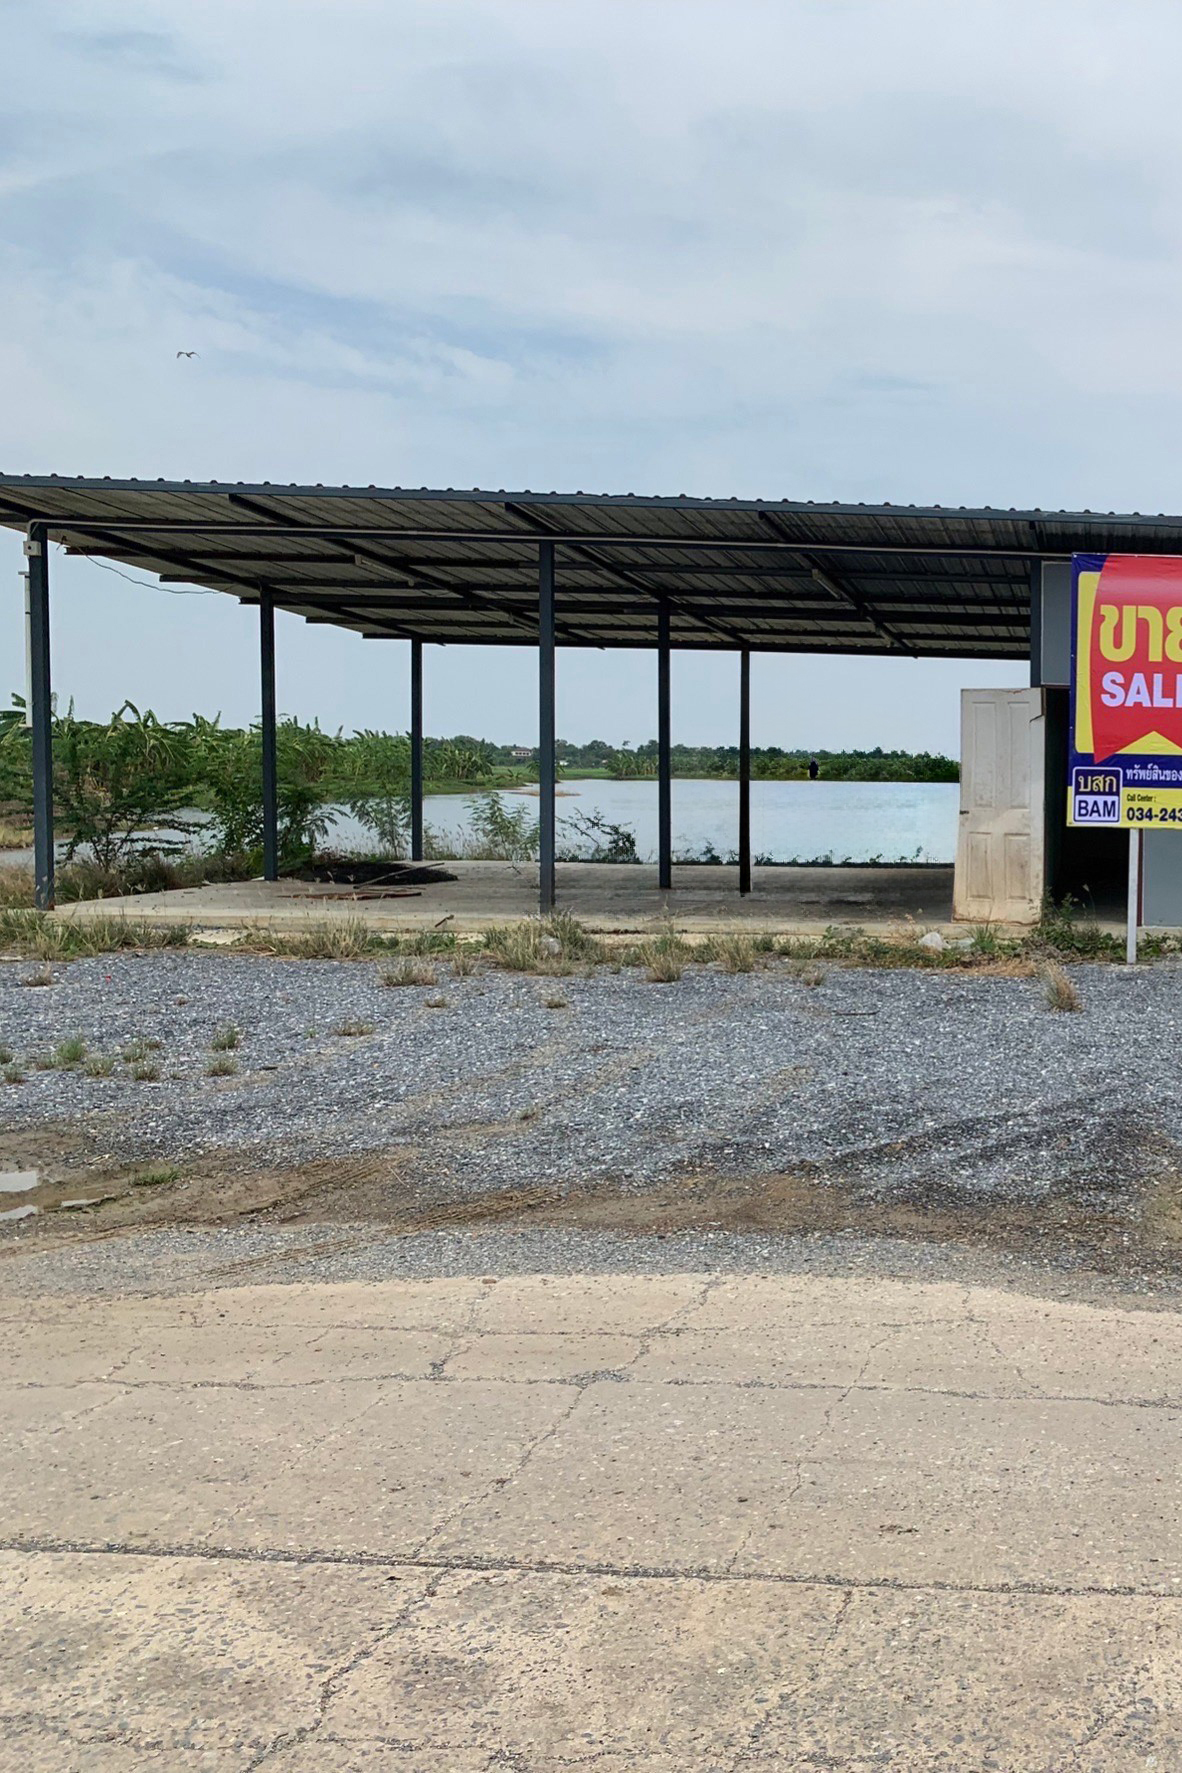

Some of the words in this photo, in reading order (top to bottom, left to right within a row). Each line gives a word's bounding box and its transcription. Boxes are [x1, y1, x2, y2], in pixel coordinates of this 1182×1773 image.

[1078, 774, 1117, 793] บสก
[1126, 793, 1136, 802] Call
[1077, 799, 1116, 818] BAM
